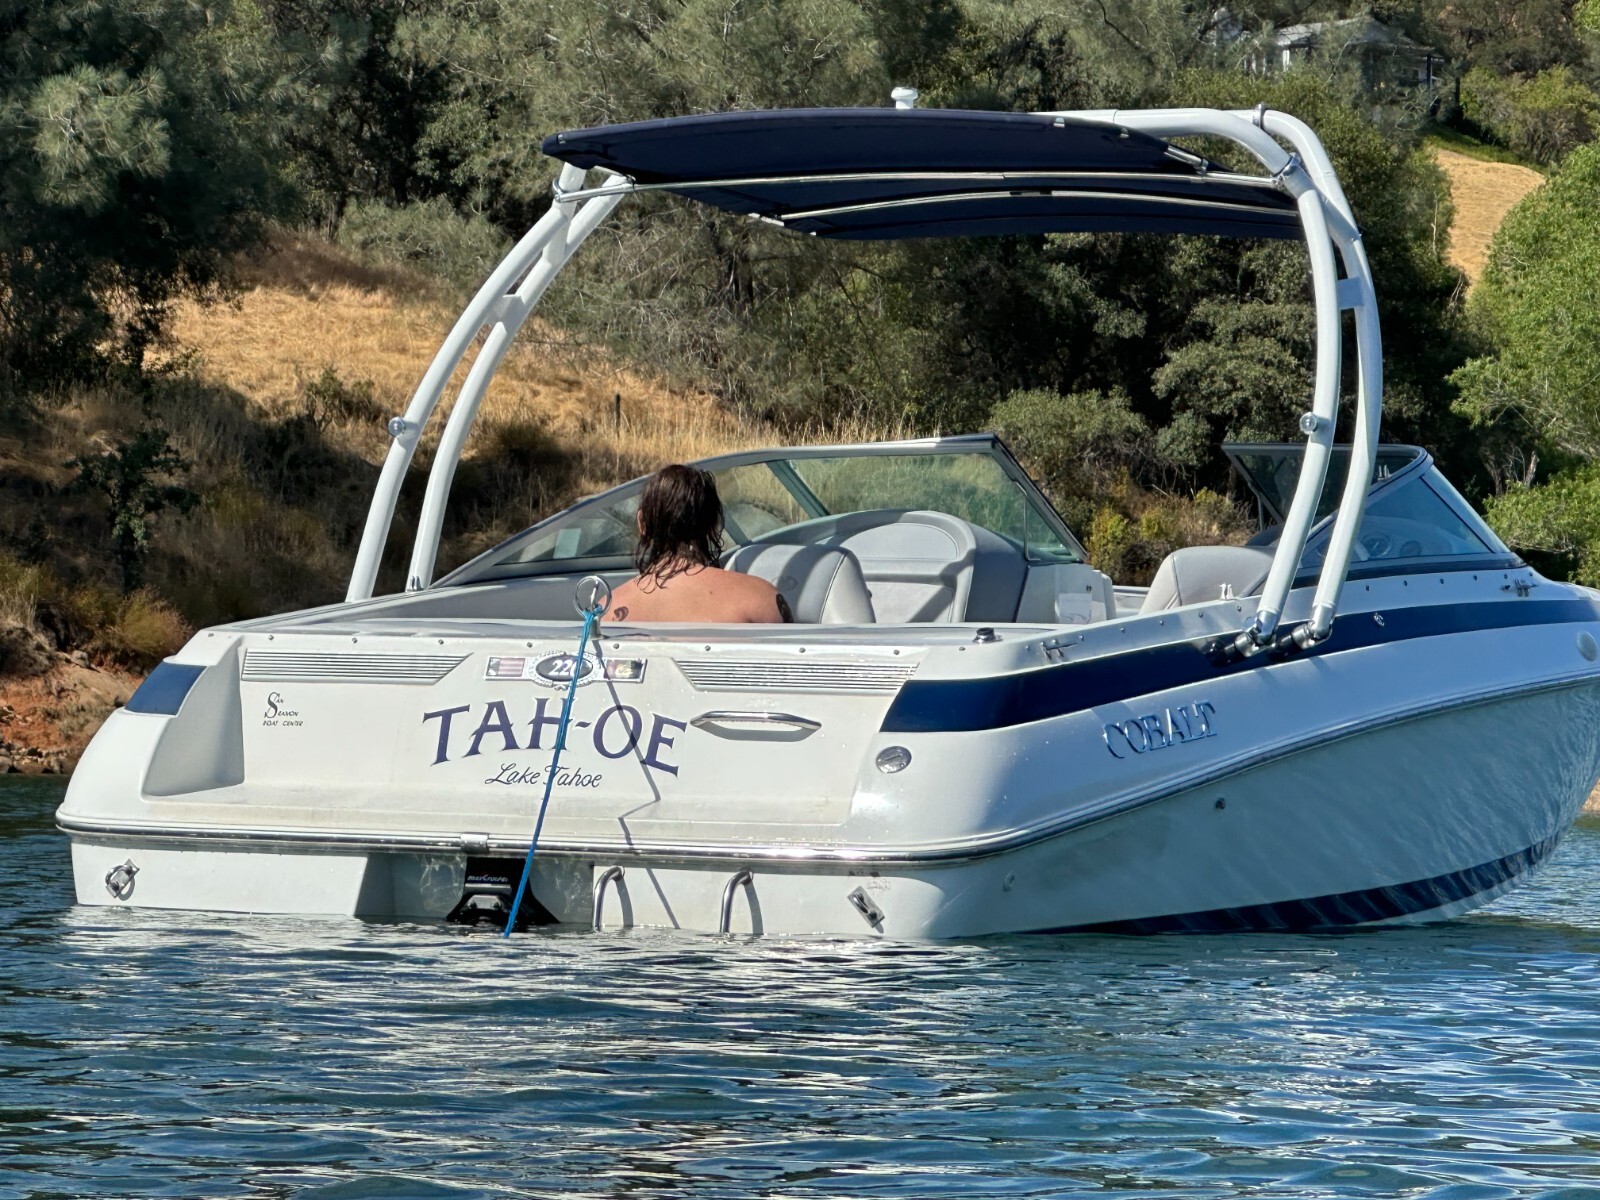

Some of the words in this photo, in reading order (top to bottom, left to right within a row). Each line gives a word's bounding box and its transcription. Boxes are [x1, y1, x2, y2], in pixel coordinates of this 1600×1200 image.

[422, 697, 687, 778] TAH-OE
[1102, 701, 1217, 760] COBALT
[484, 762, 541, 785] Lake
